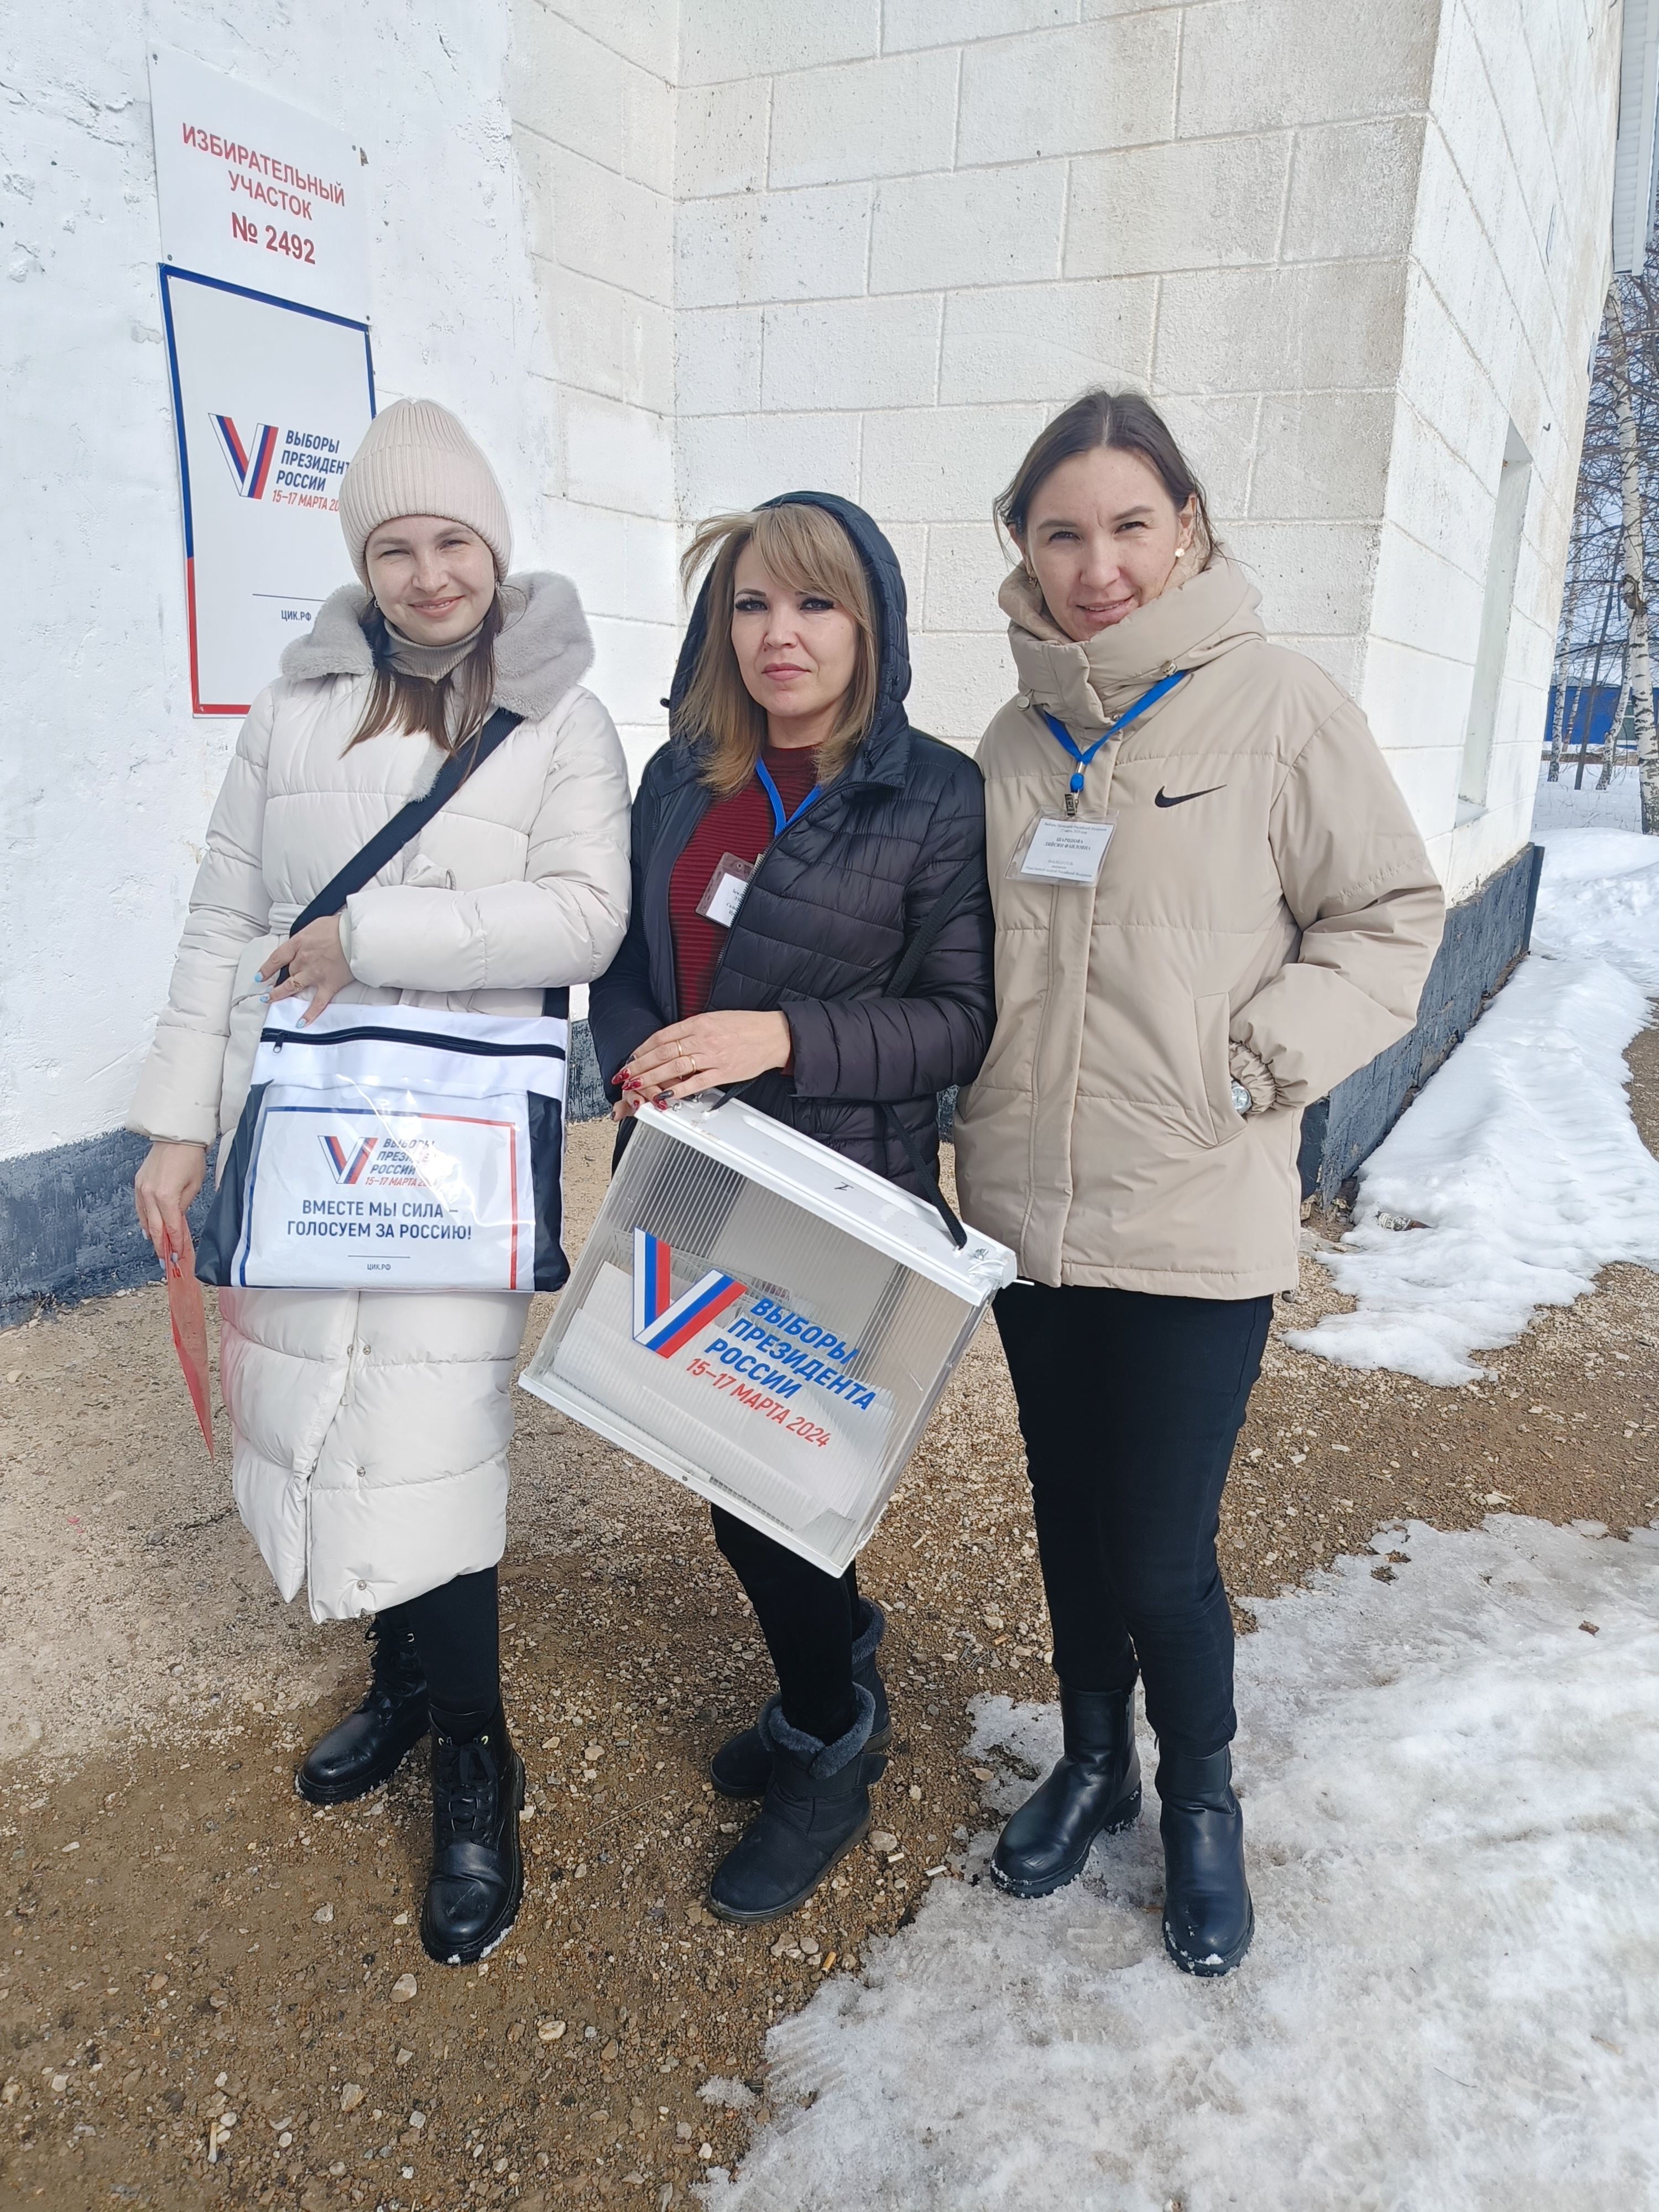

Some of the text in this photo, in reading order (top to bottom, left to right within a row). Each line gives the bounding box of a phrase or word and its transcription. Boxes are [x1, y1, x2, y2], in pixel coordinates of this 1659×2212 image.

[182, 122, 345, 207] ИЗБИРАТЕЛЬНЫЙ
[228, 170, 312, 221] УЧАСТОК
[232, 212, 316, 264] № 2492
[285, 430, 340, 453] ВЫБОРЫ
[281, 450, 351, 475] ПРЕЗИДЕНТ
[276, 469, 326, 492] РОССИИ
[298, 494, 327, 510] МАРТА
[329, 499, 340, 512] 20
[281, 610, 311, 622] ЦИК.РФ
[370, 1164, 416, 1175] РОССИИ
[389, 1177, 417, 1187] МАРТА
[302, 1199, 364, 1216] ВМЕСТЕ
[369, 1202, 397, 1217] МЫ
[402, 1202, 444, 1218] СИЛА
[287, 1220, 471, 1240] ГОЛОСУЕМ ЗА РОССИЮ!
[750, 1297, 860, 1365] ВЫБОРЫ
[704, 1338, 803, 1399] РОССИИ
[727, 1318, 877, 1410] ПРЕЗИДЕНТА
[729, 1383, 791, 1425] МАРТА
[786, 1416, 831, 1447] 2024
